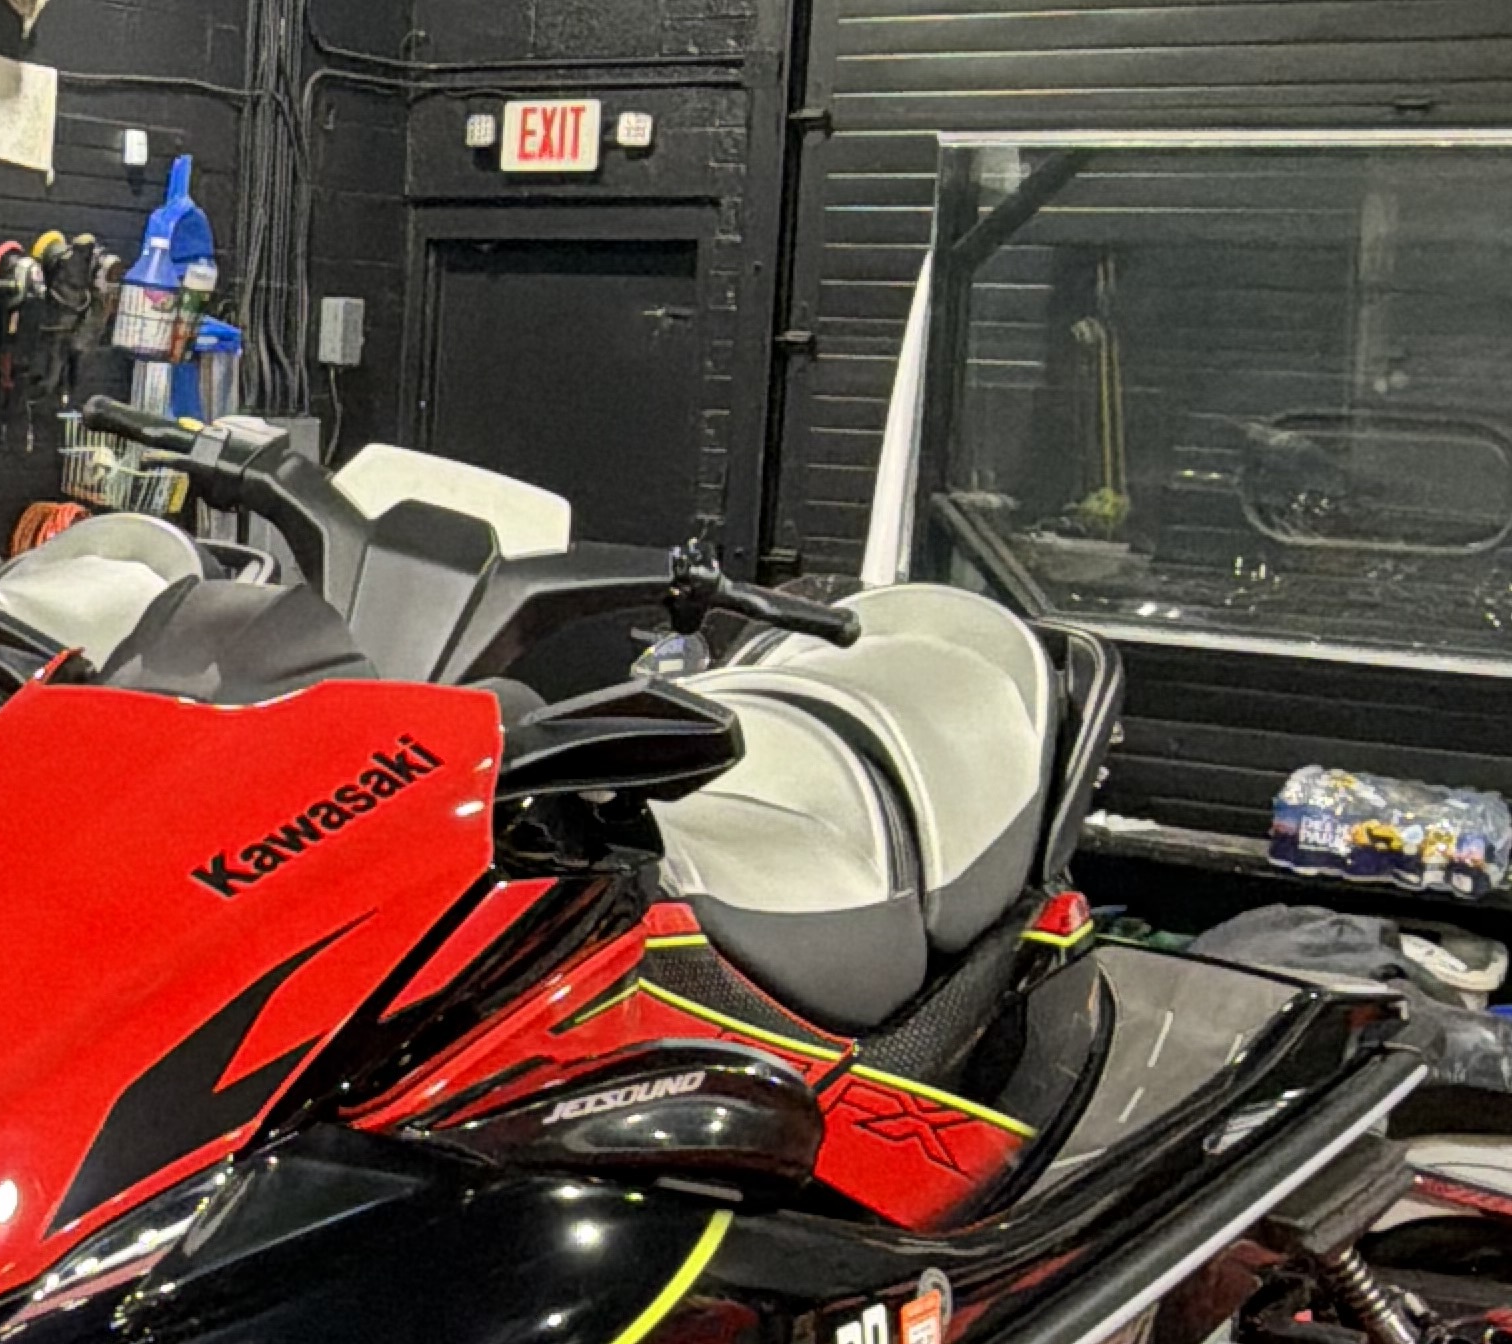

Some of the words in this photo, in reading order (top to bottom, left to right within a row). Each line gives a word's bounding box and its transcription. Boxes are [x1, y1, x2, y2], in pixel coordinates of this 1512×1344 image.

[517, 105, 586, 161] EXIT
[190, 733, 445, 898] Kawasaki
[542, 1070, 707, 1126] JETSOUND
